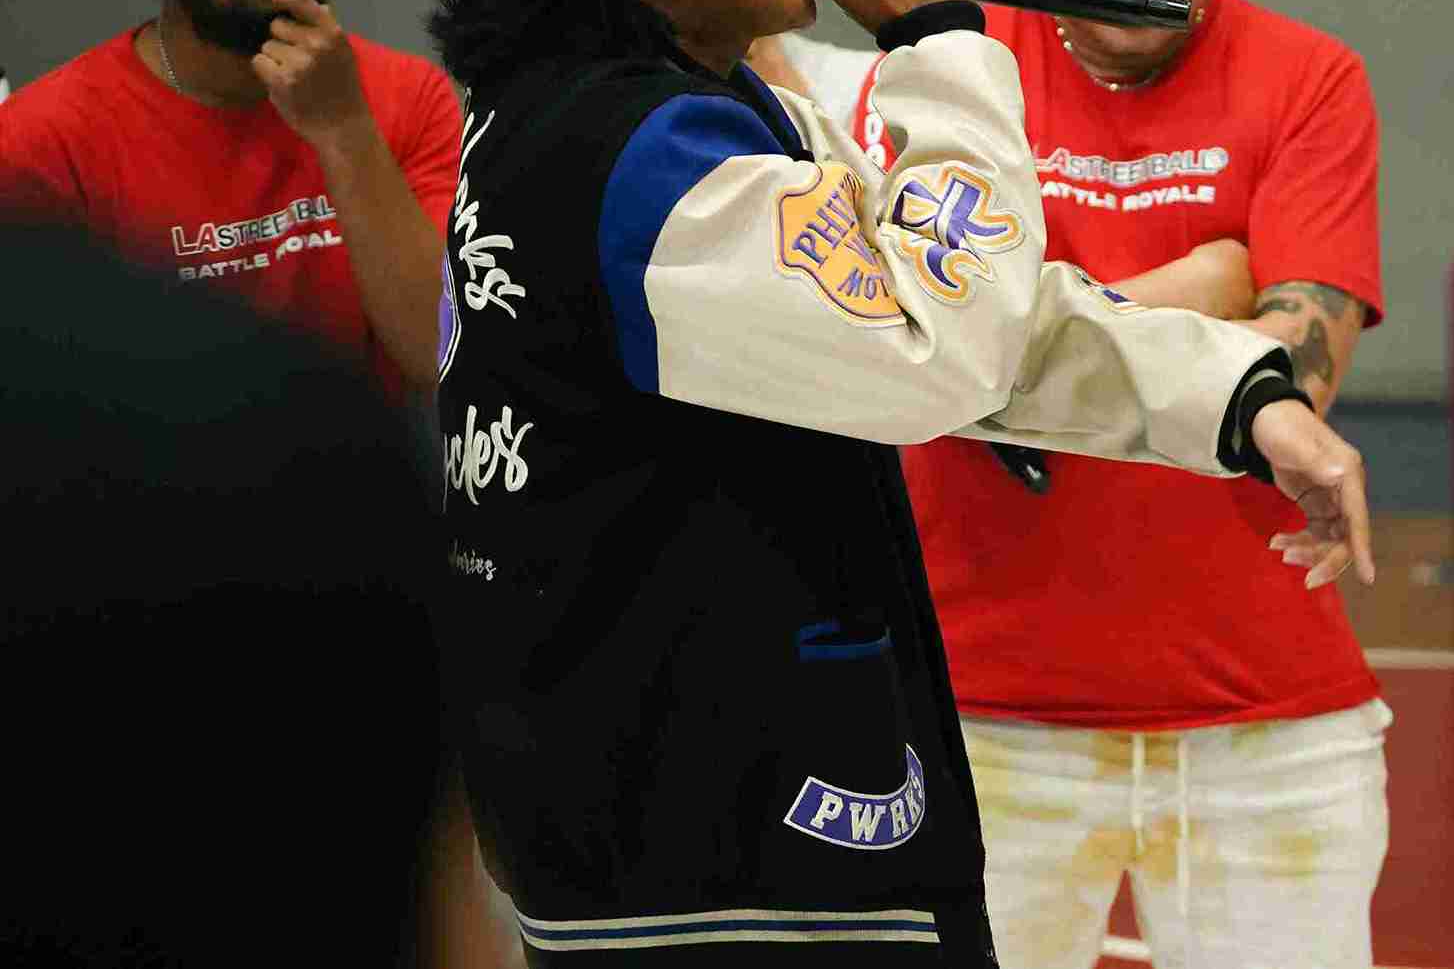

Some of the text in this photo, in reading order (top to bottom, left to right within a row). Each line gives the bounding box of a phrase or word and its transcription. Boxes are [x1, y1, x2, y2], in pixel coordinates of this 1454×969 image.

[1040, 181, 1216, 212] ATTLE ROYALE
[178, 252, 271, 281] BATTLE
